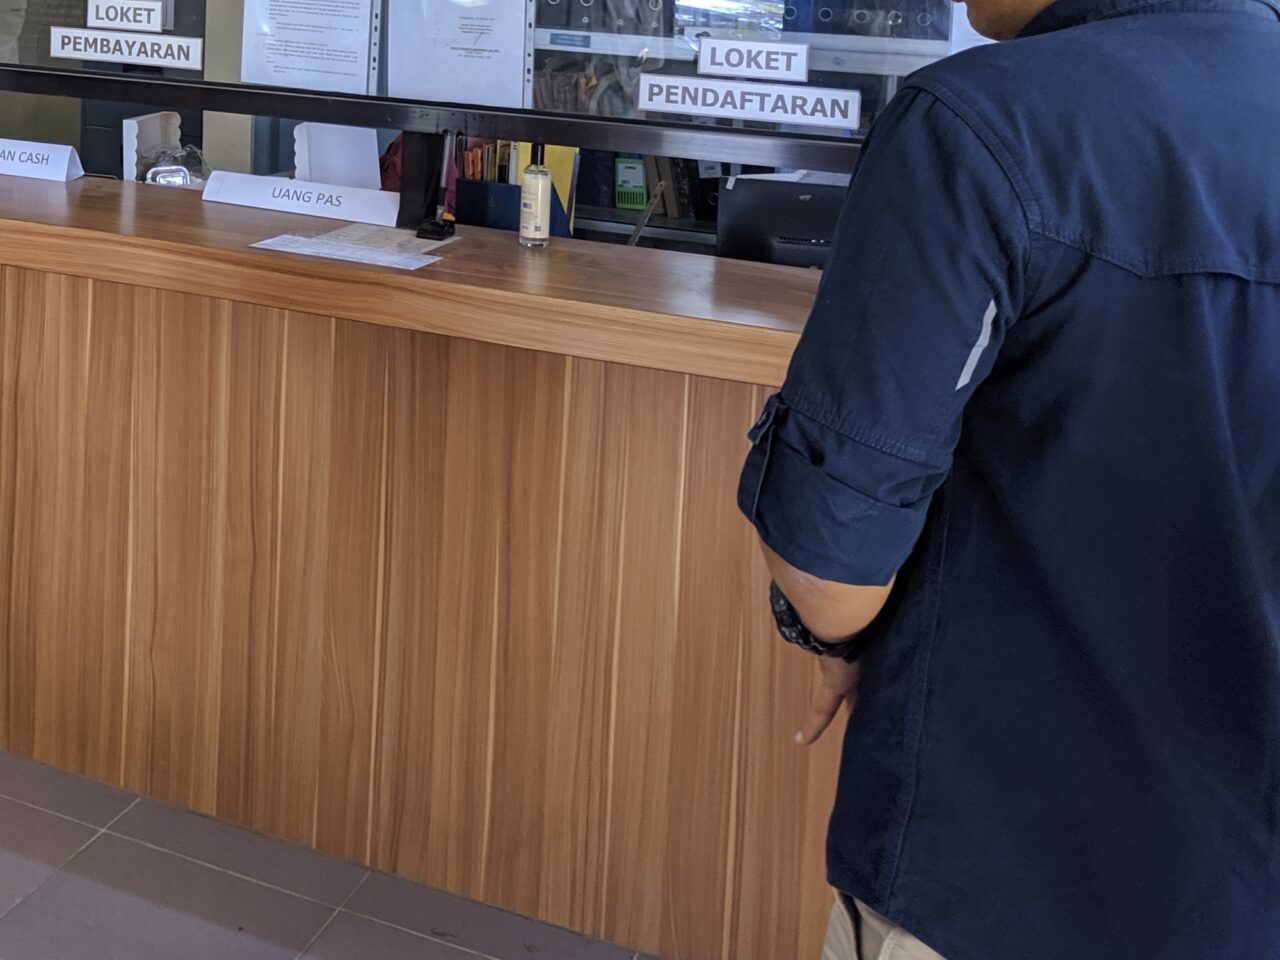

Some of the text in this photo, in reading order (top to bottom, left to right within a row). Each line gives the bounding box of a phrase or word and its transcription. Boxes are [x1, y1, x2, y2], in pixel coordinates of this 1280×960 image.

[95, 5, 155, 25] LOKET
[60, 35, 190, 61] PEMBAYARAN
[710, 47, 798, 71] LOKET
[647, 83, 850, 119] PENDAFTARAN
[19, 151, 50, 166] CASH
[272, 187, 344, 207] UANG PAS
